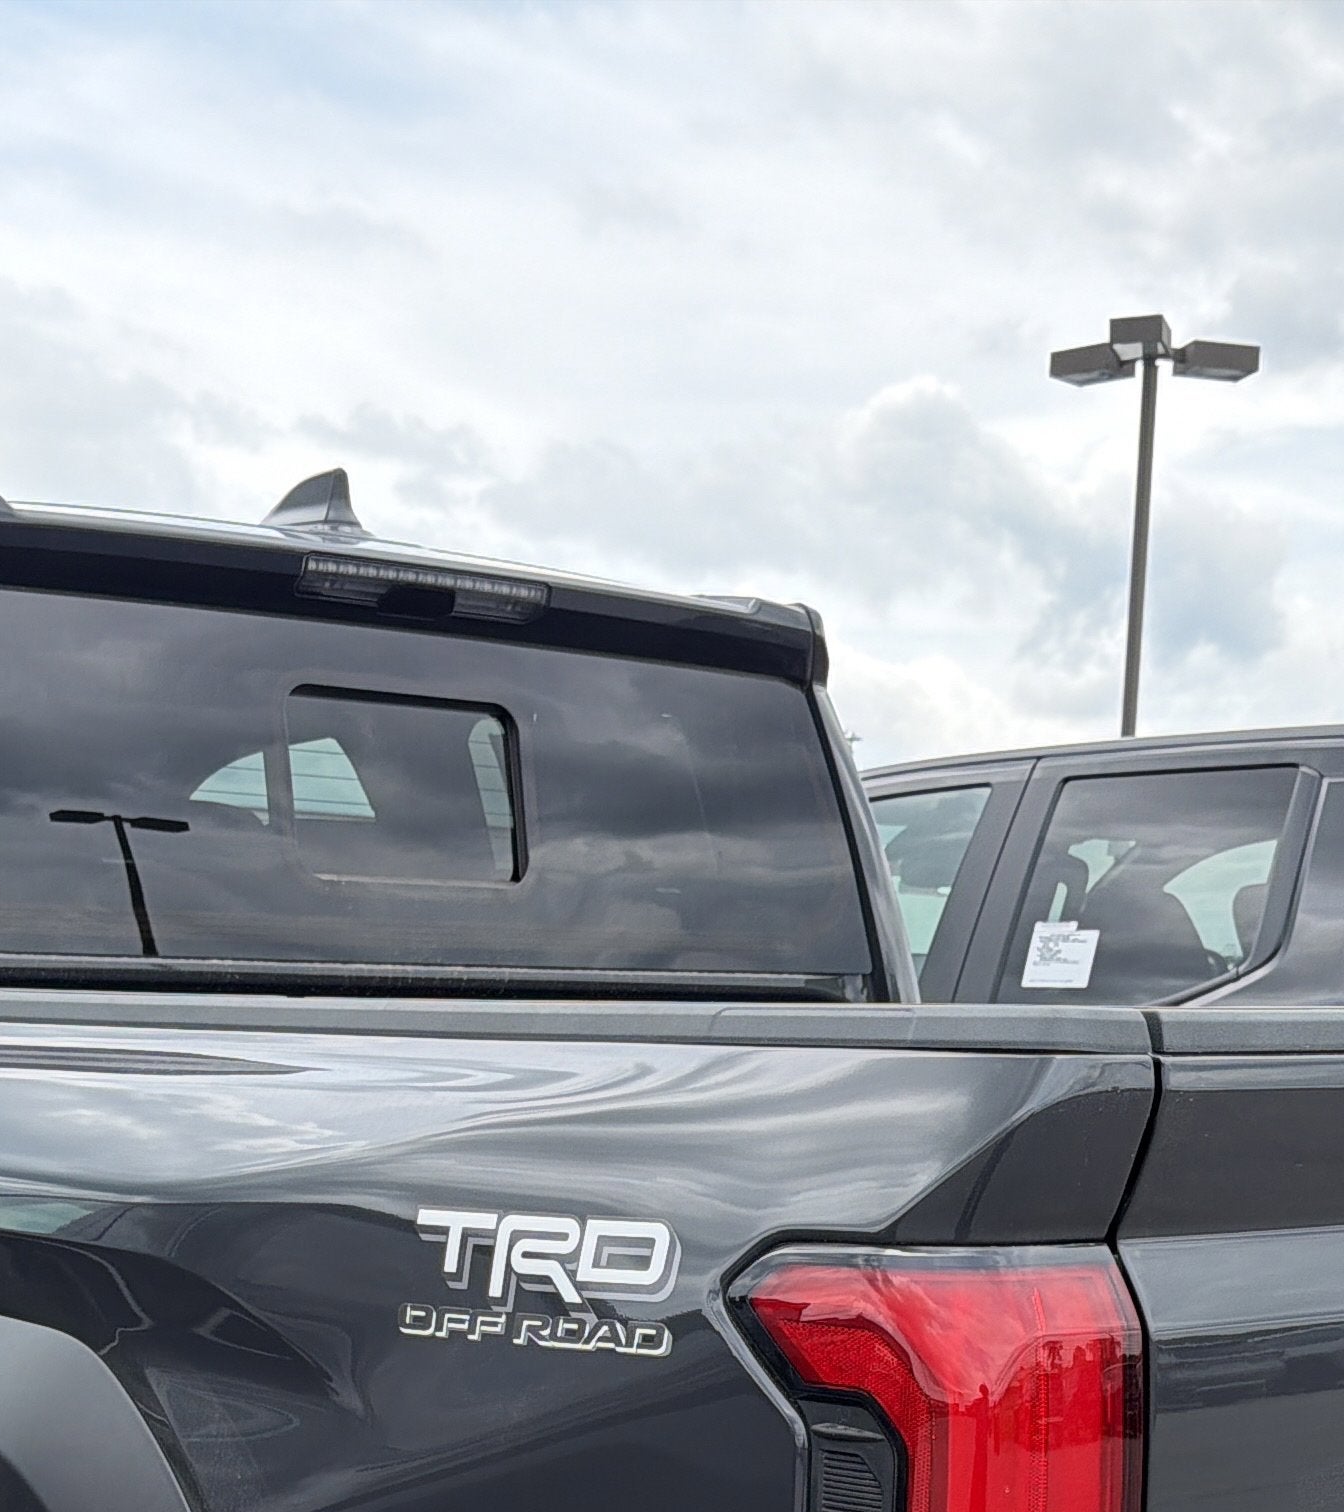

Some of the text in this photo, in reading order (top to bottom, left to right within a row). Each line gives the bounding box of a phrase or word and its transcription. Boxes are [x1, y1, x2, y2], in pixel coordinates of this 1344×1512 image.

[416, 1206, 682, 1314] TRD
[398, 1303, 673, 1357] OFF ROAD
